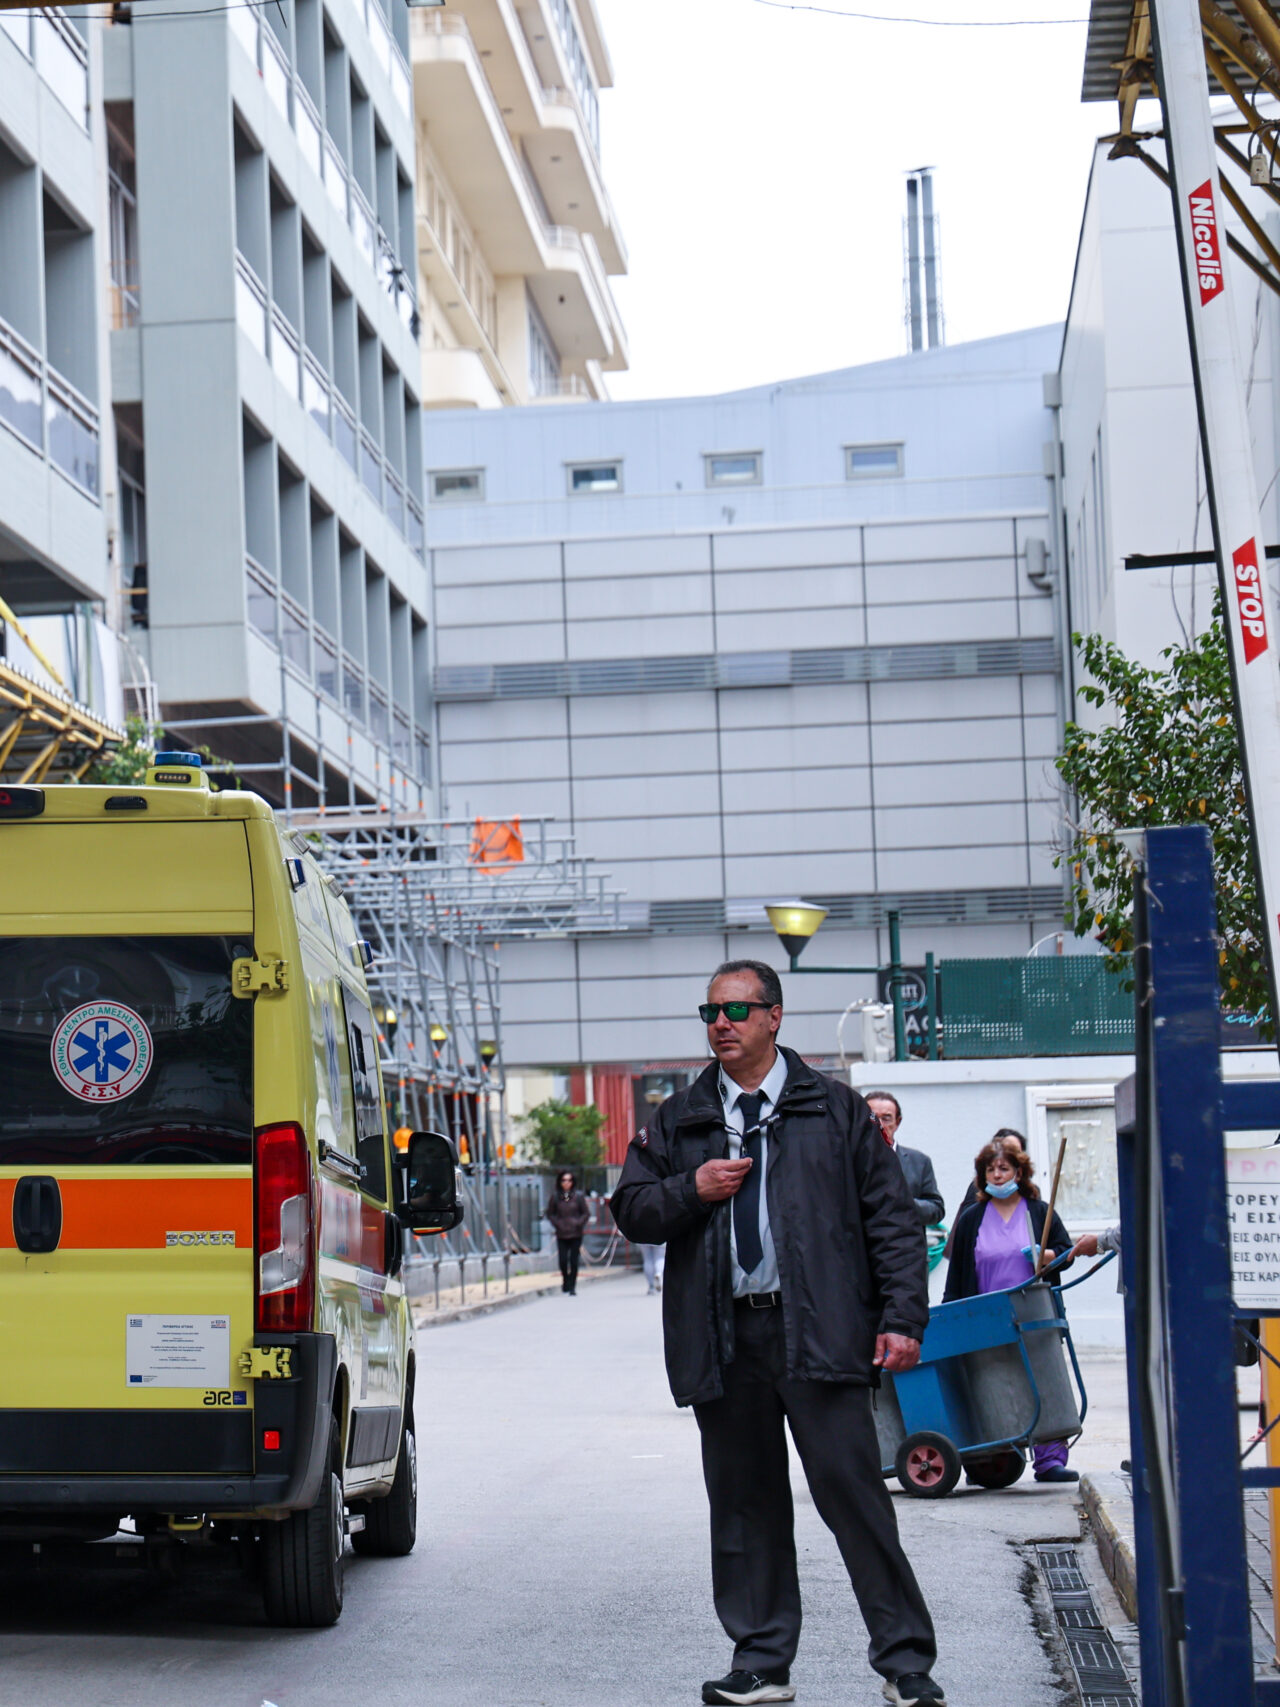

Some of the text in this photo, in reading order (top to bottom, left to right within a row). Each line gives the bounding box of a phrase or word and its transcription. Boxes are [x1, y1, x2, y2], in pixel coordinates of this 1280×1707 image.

[1191, 197, 1221, 290] Nicolis
[1236, 564, 1264, 638] STOP
[57, 1007, 147, 1077] ΕΘΝΙΚΟ ΚΕΝΤΡΟ ΑΜΕΣΗΣ ΒΟΗΘΕΙΑΣ
[80, 1084, 121, 1097] Ε.Σ.Υ
[166, 1231, 236, 1246] BOXER
[1247, 1212, 1280, 1223] ΕΙΣ
